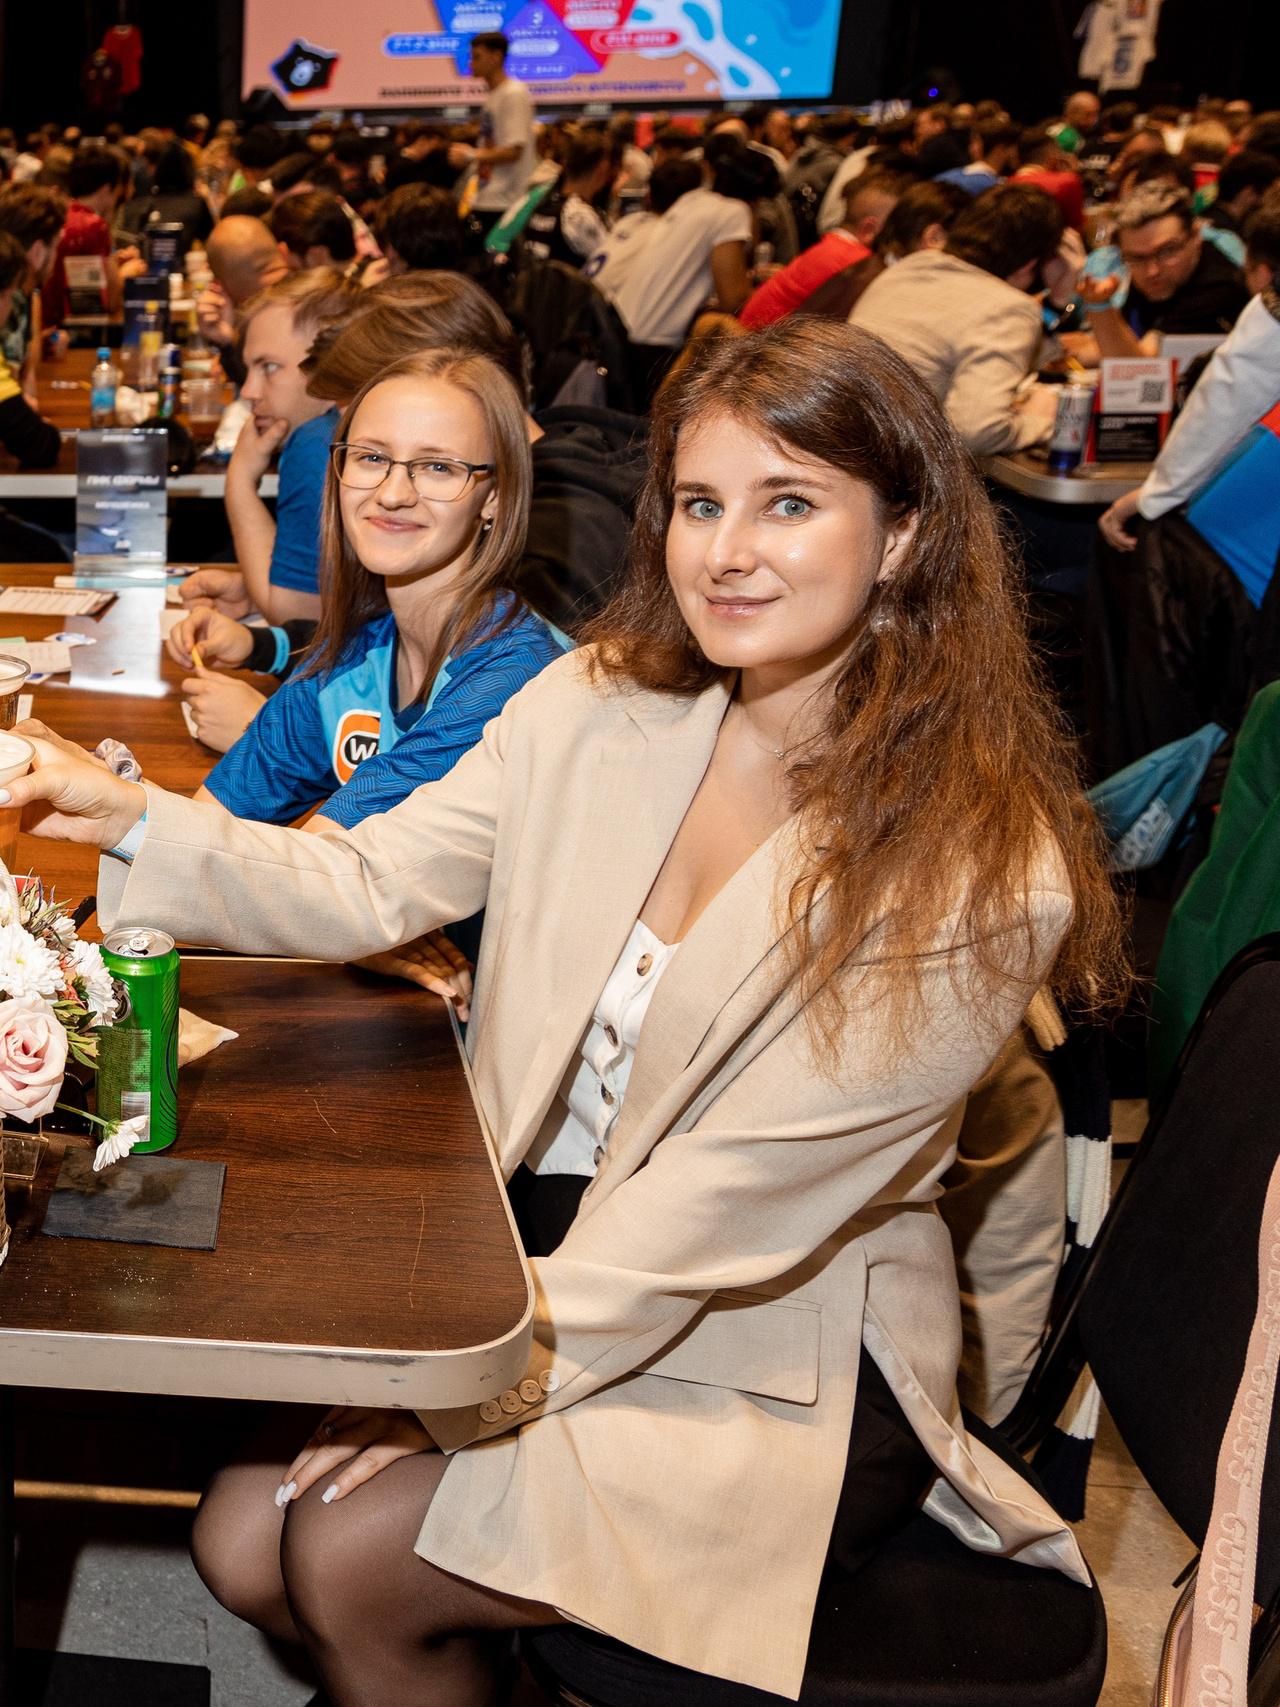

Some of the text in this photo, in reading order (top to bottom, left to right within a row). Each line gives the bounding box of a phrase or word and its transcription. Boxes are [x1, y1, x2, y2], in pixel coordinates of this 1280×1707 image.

[349, 738, 380, 762] W
[1227, 1365, 1271, 1488] GUESS
[1204, 1511, 1248, 1642] GUESS
